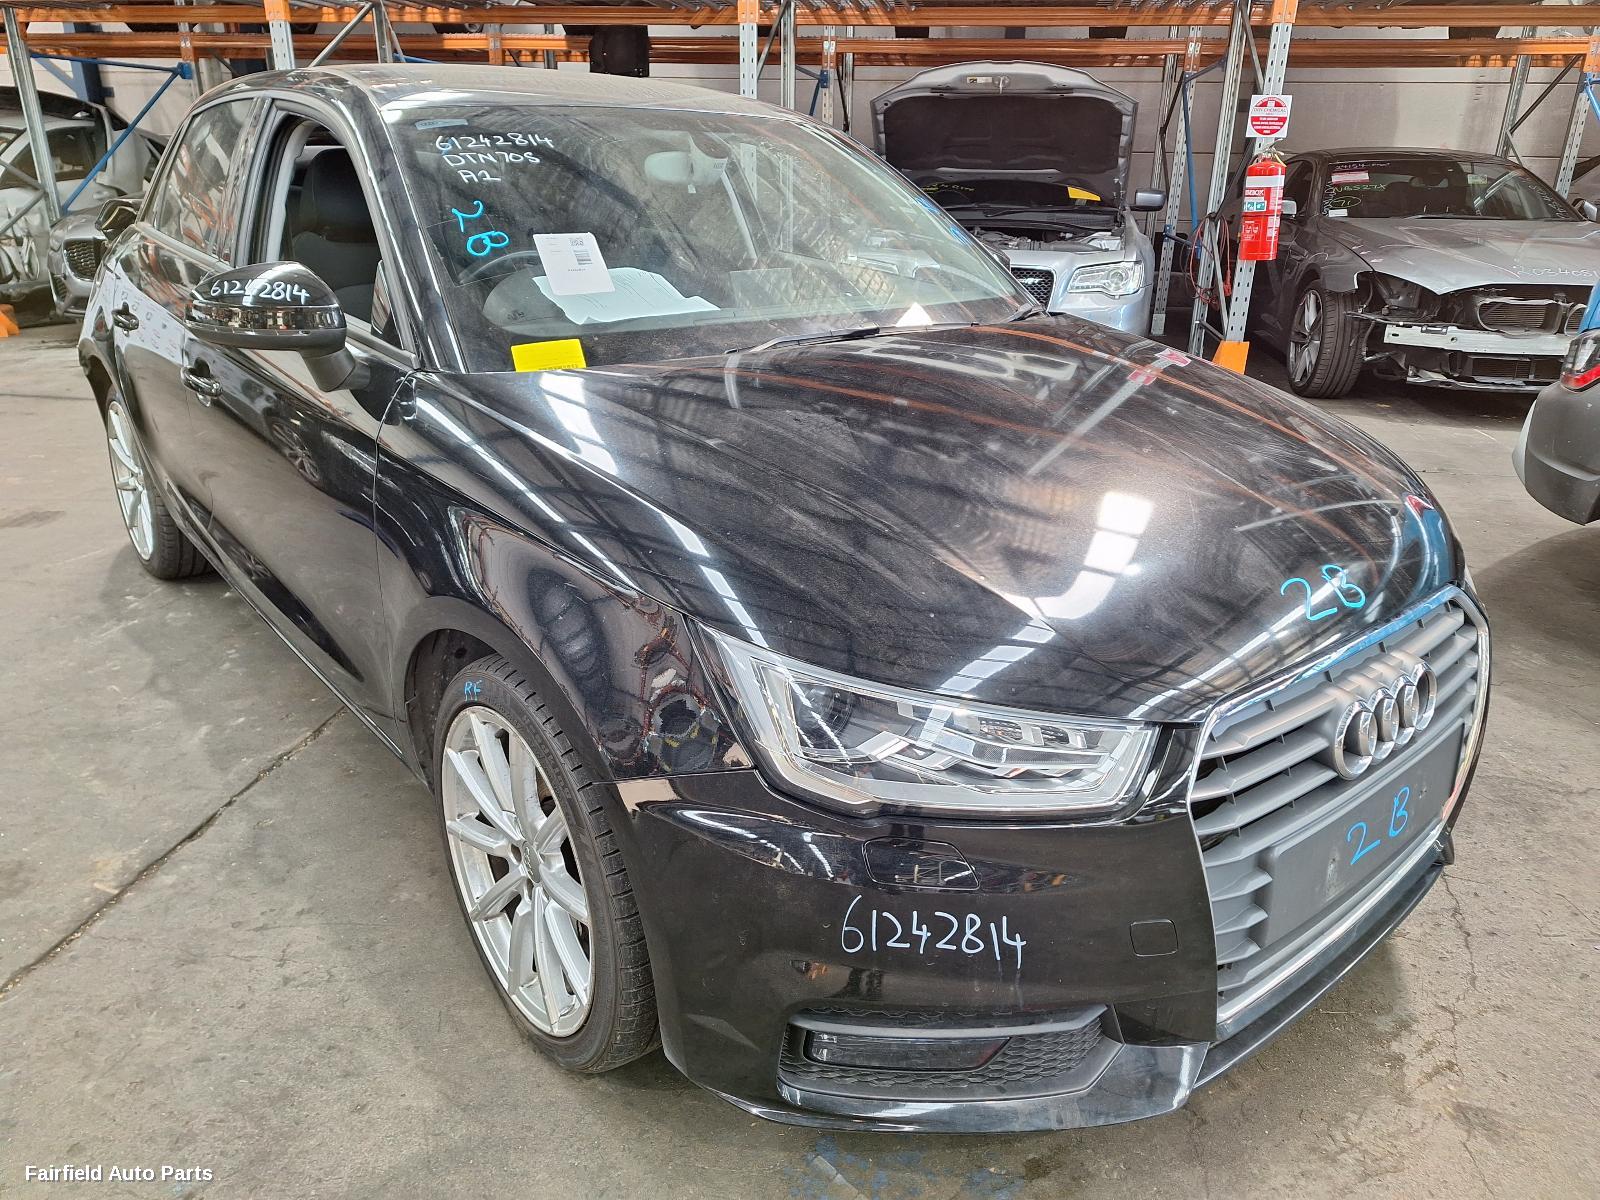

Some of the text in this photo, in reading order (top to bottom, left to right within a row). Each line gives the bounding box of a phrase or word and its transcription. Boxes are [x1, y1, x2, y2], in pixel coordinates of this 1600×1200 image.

[435, 132, 554, 151] 61242814
[210, 279, 310, 304] 61242814
[464, 680, 482, 696] RF
[841, 895, 1027, 969] 61242814
